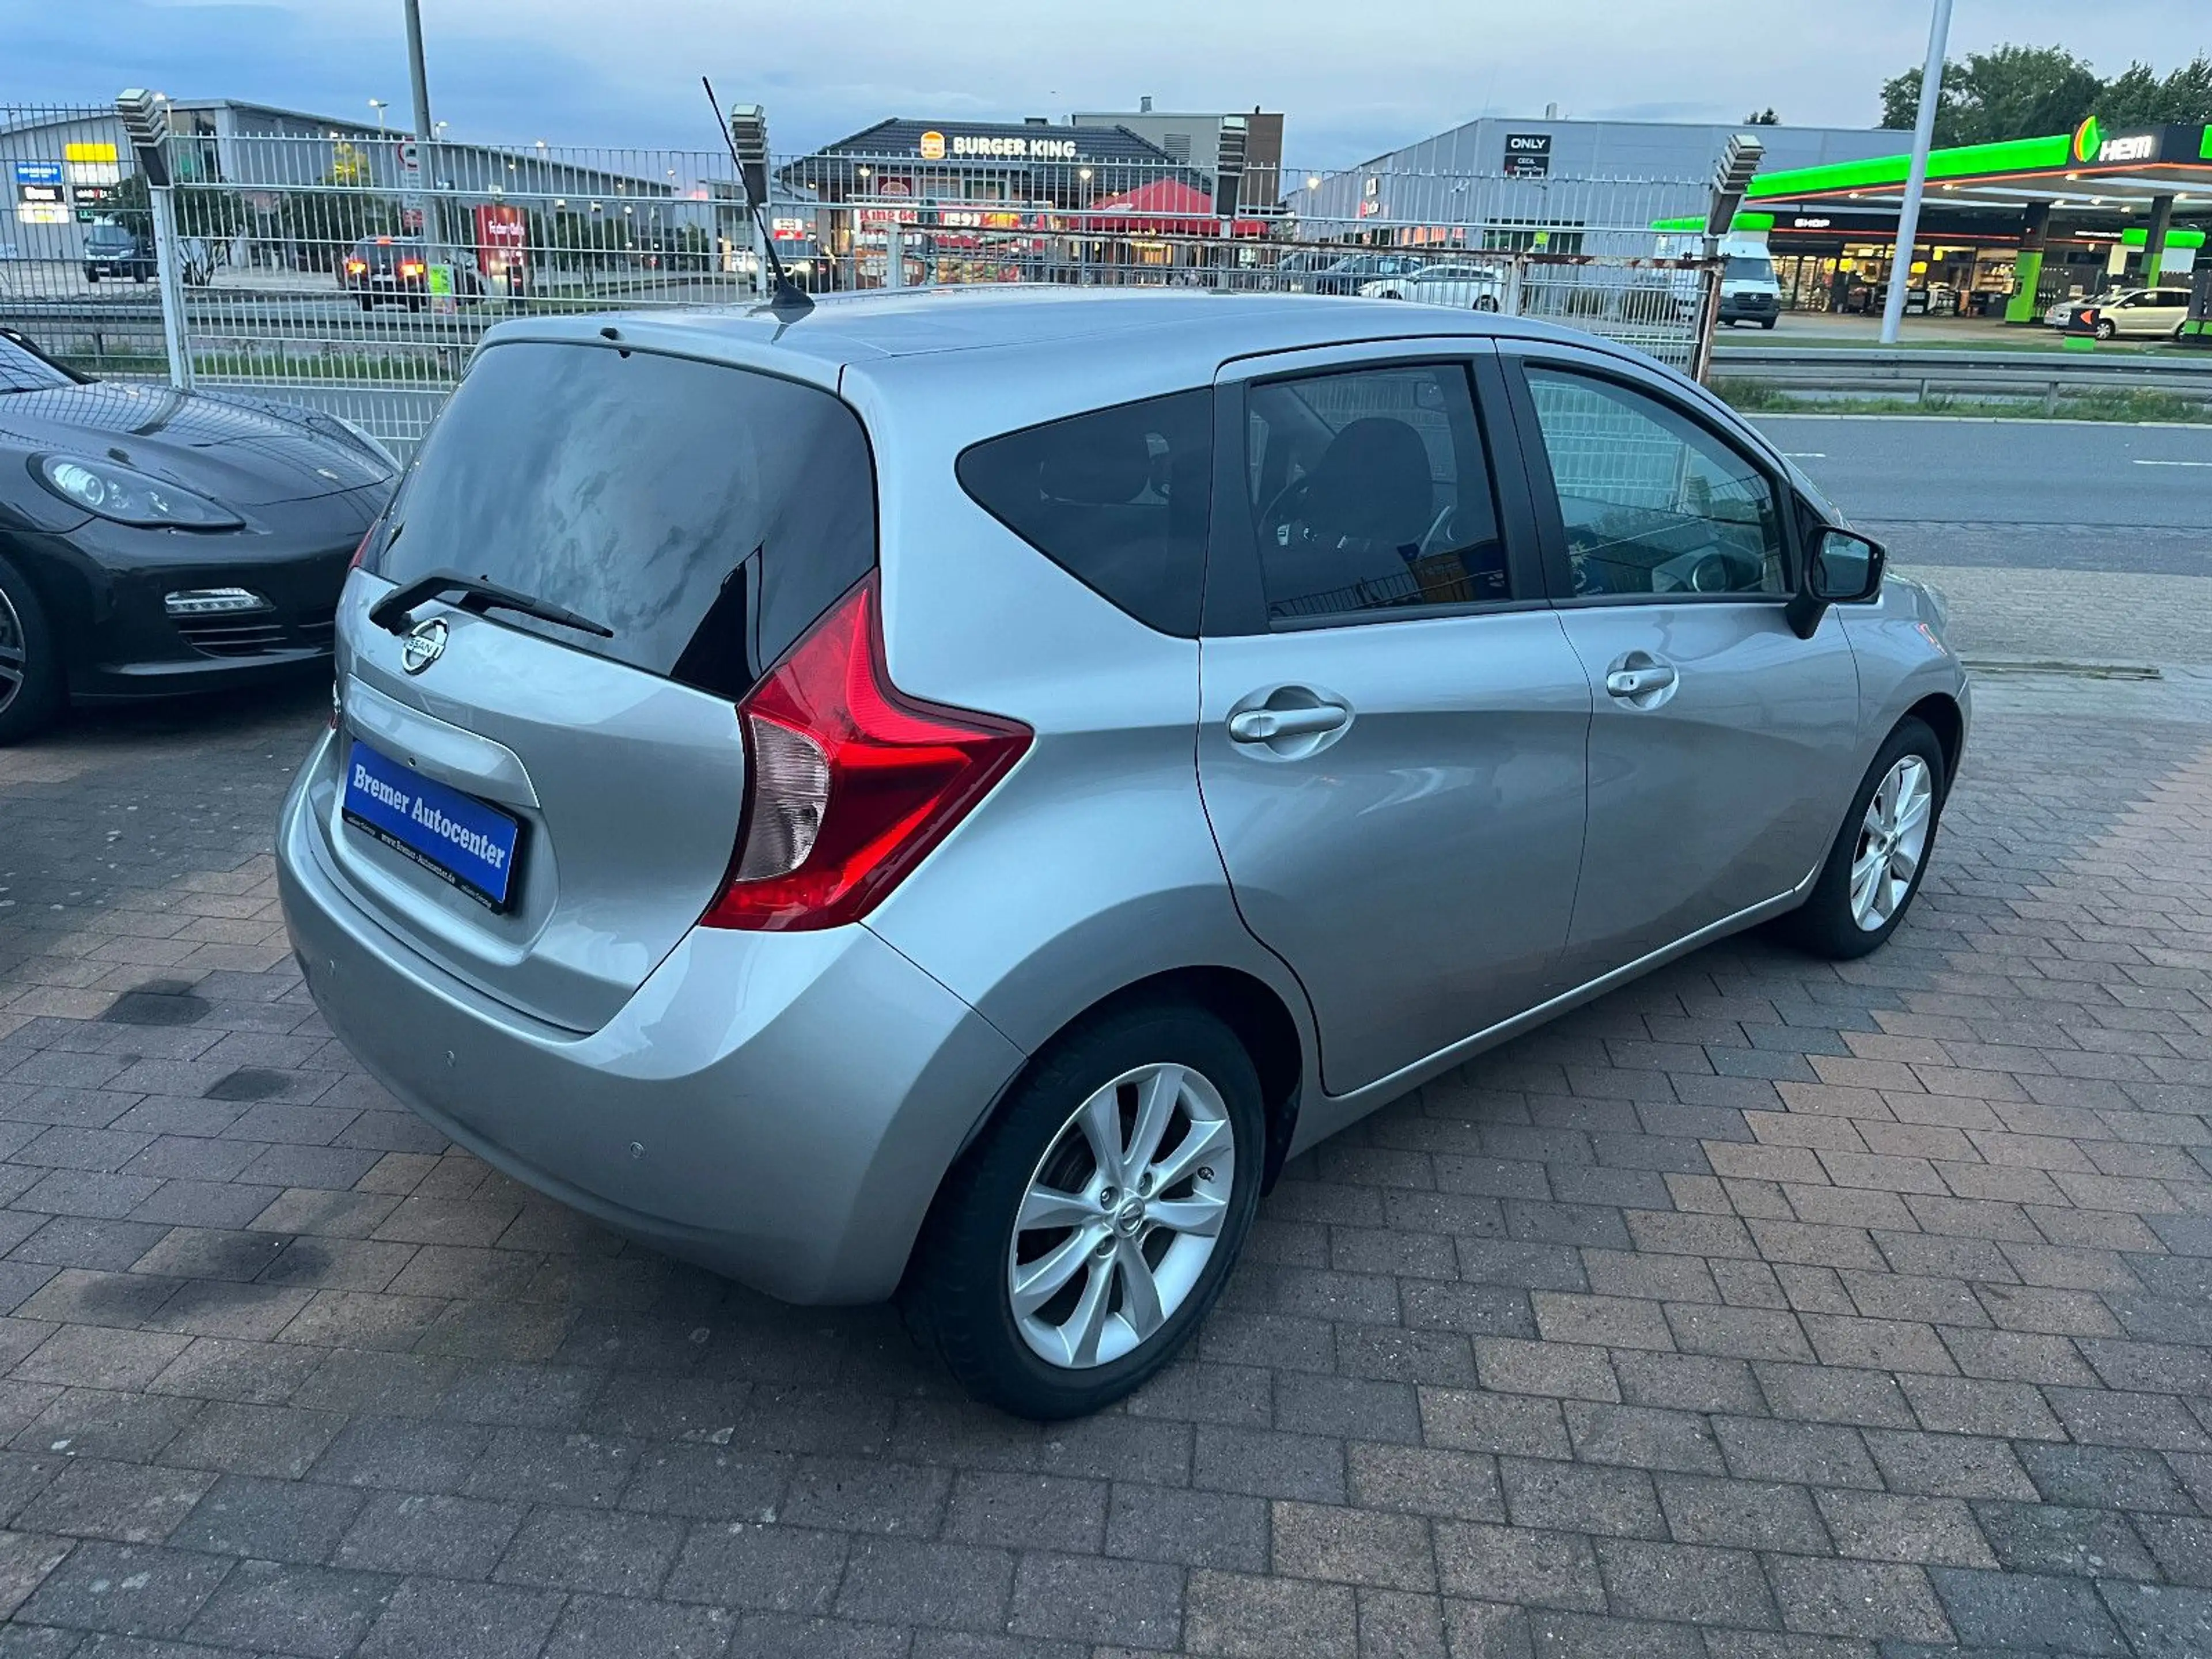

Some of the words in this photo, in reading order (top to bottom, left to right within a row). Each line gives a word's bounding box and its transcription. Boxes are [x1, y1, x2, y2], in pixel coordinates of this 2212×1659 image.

[953, 137, 1027, 156] BURGER
[1030, 139, 1076, 157] KING
[1510, 138, 1546, 149] ONLY
[1794, 218, 1830, 228] SHOP
[353, 763, 410, 814] Bremer
[412, 797, 505, 869] Autocenter
